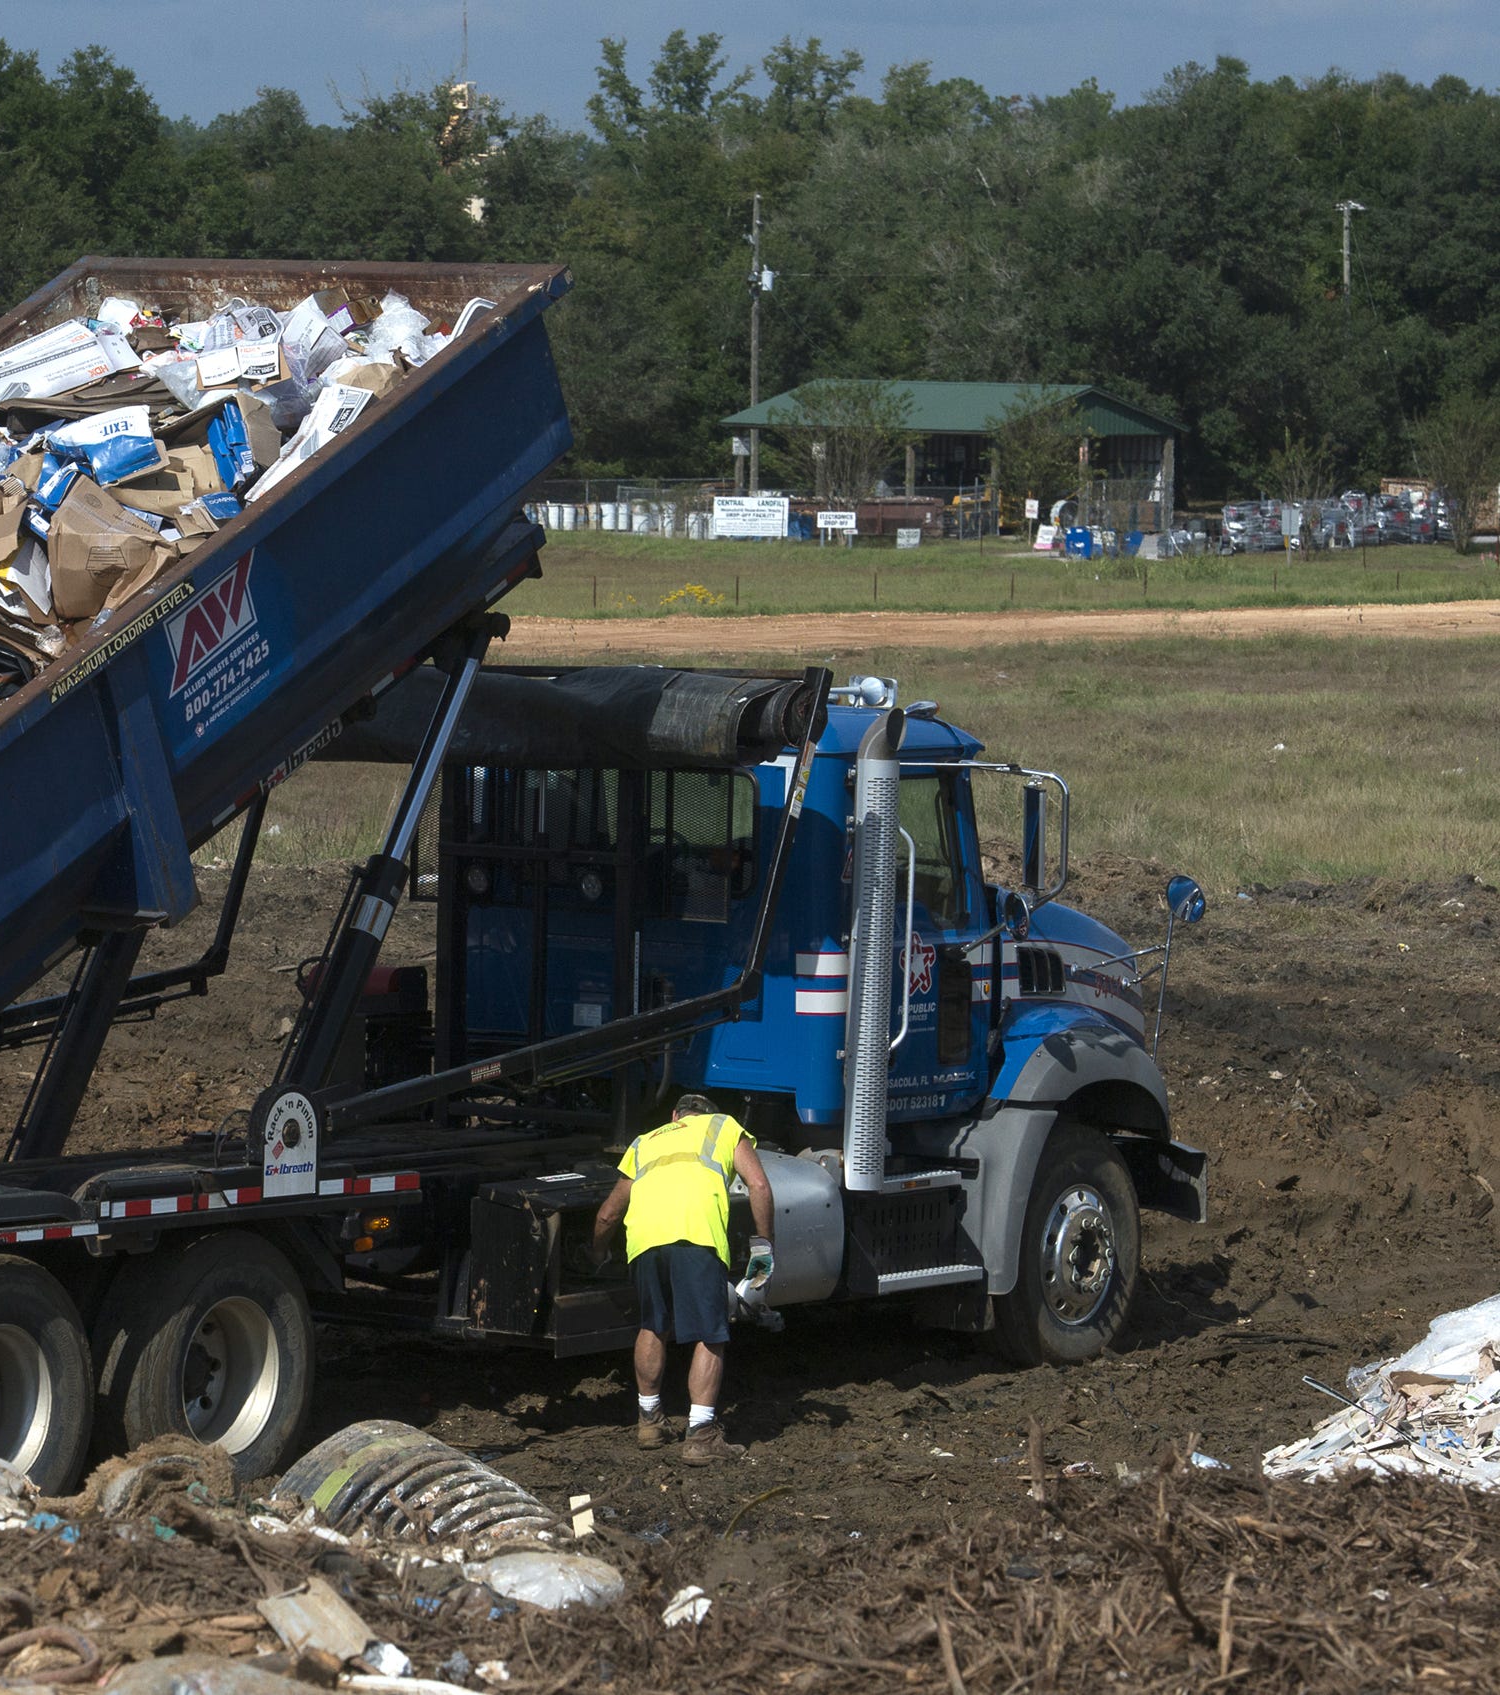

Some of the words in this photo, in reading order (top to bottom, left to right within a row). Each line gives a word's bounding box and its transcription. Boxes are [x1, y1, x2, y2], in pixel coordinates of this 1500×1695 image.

[88, 364, 110, 378] HDX
[103, 420, 129, 436] EXIT
[108, 615, 155, 659] LOADING
[155, 588, 189, 619] LEVEL
[183, 676, 206, 700] ALLIED
[206, 659, 229, 681] WASTE
[229, 631, 260, 662] SERVICES
[185, 640, 270, 722] 800-774-7425
[209, 704, 230, 724] REPUBLIC
[250, 669, 270, 691] COMPANY
[898, 1002, 937, 1016] RPUBLIC
[920, 1075, 929, 1085] FL
[910, 1094, 946, 1109] 523181
[267, 1106, 284, 1141] Rack
[296, 1099, 314, 1139] Pinion
